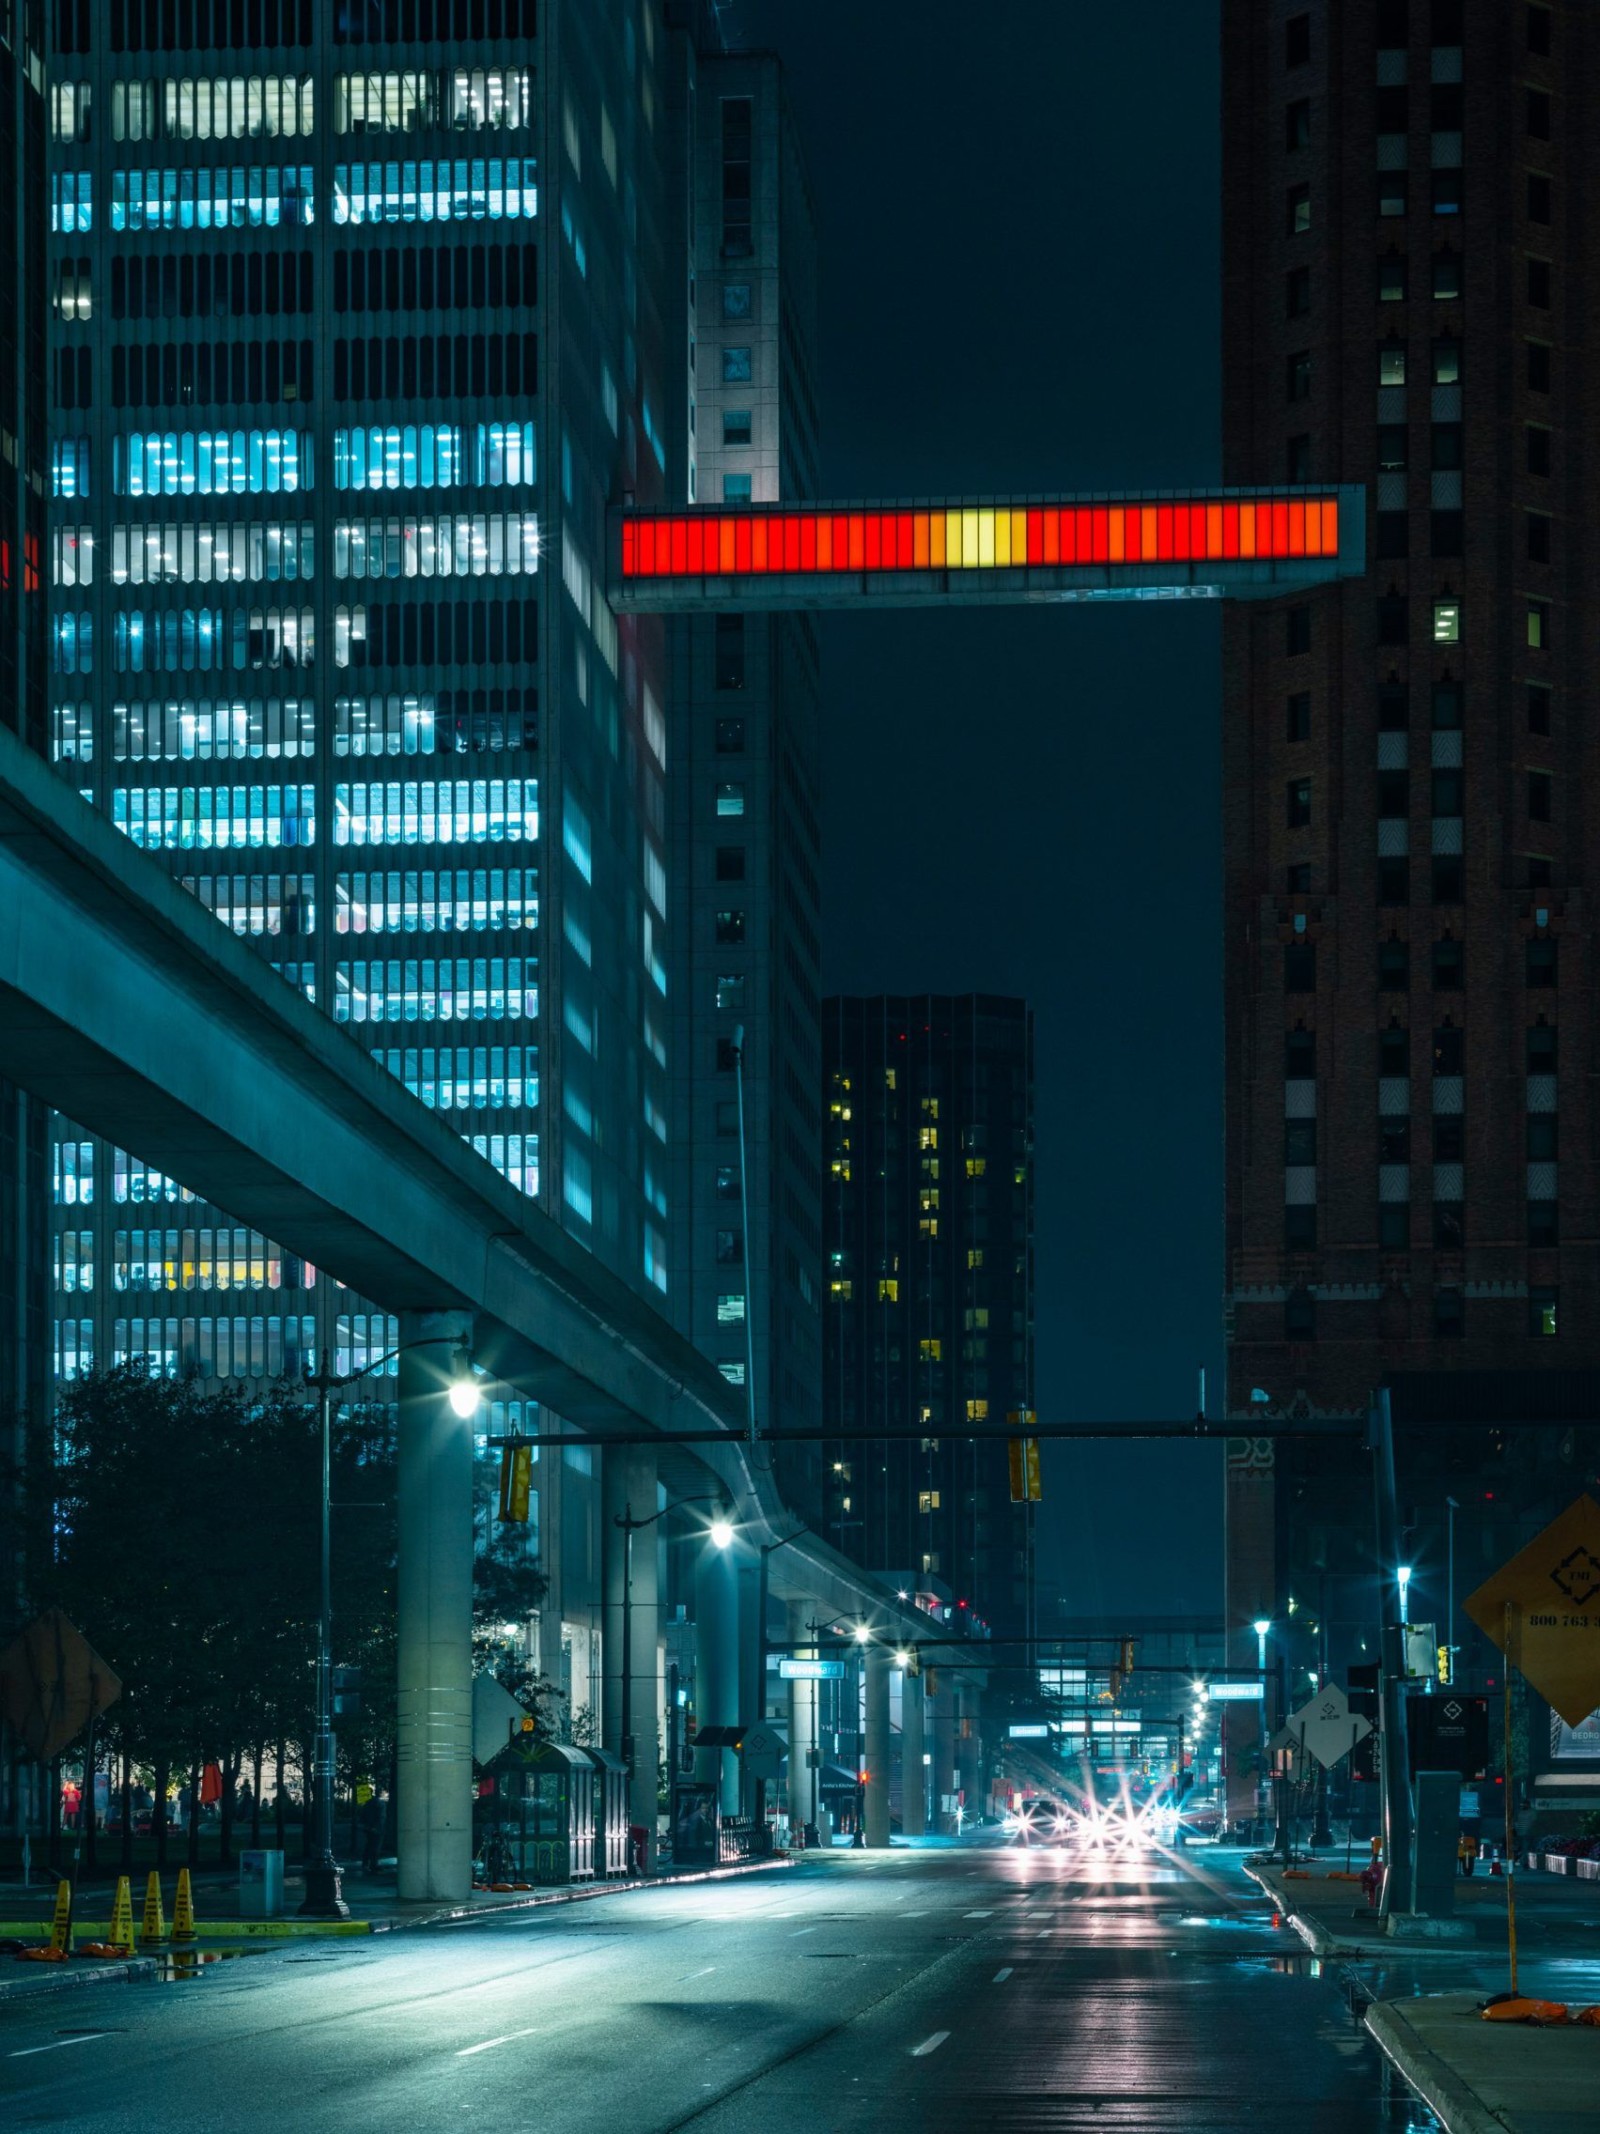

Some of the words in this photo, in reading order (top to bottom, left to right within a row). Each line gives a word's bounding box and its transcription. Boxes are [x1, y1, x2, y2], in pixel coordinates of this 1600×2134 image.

[1530, 1615, 1557, 1627] 800
[1563, 1615, 1588, 1627] 763
[788, 1665, 838, 1675] Woodward
[1215, 1686, 1258, 1696] Woodward
